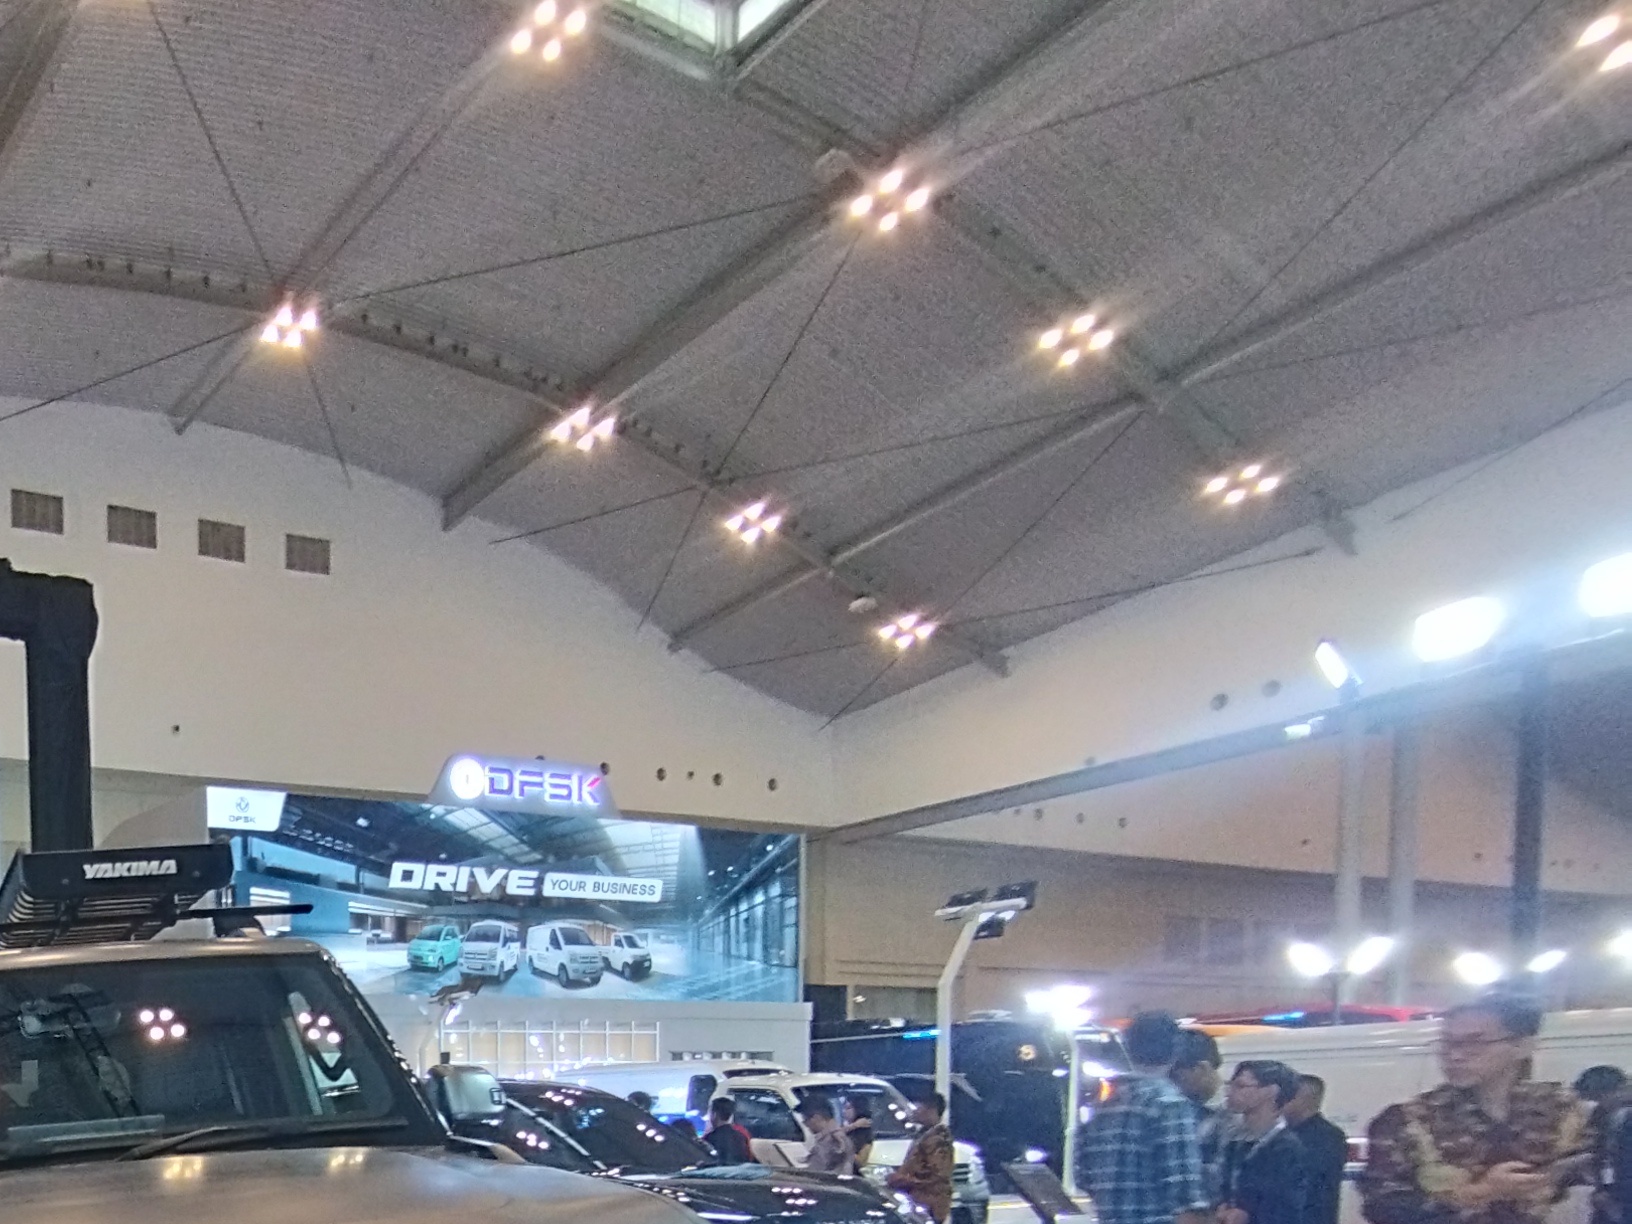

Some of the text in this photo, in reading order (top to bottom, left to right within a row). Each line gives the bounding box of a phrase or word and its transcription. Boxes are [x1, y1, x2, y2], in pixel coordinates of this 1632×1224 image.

[485, 766, 602, 805] DFSK
[83, 859, 177, 879] YAKIMA
[388, 861, 539, 896] DRIVE
[551, 878, 656, 896] YOUR BUSINESS
